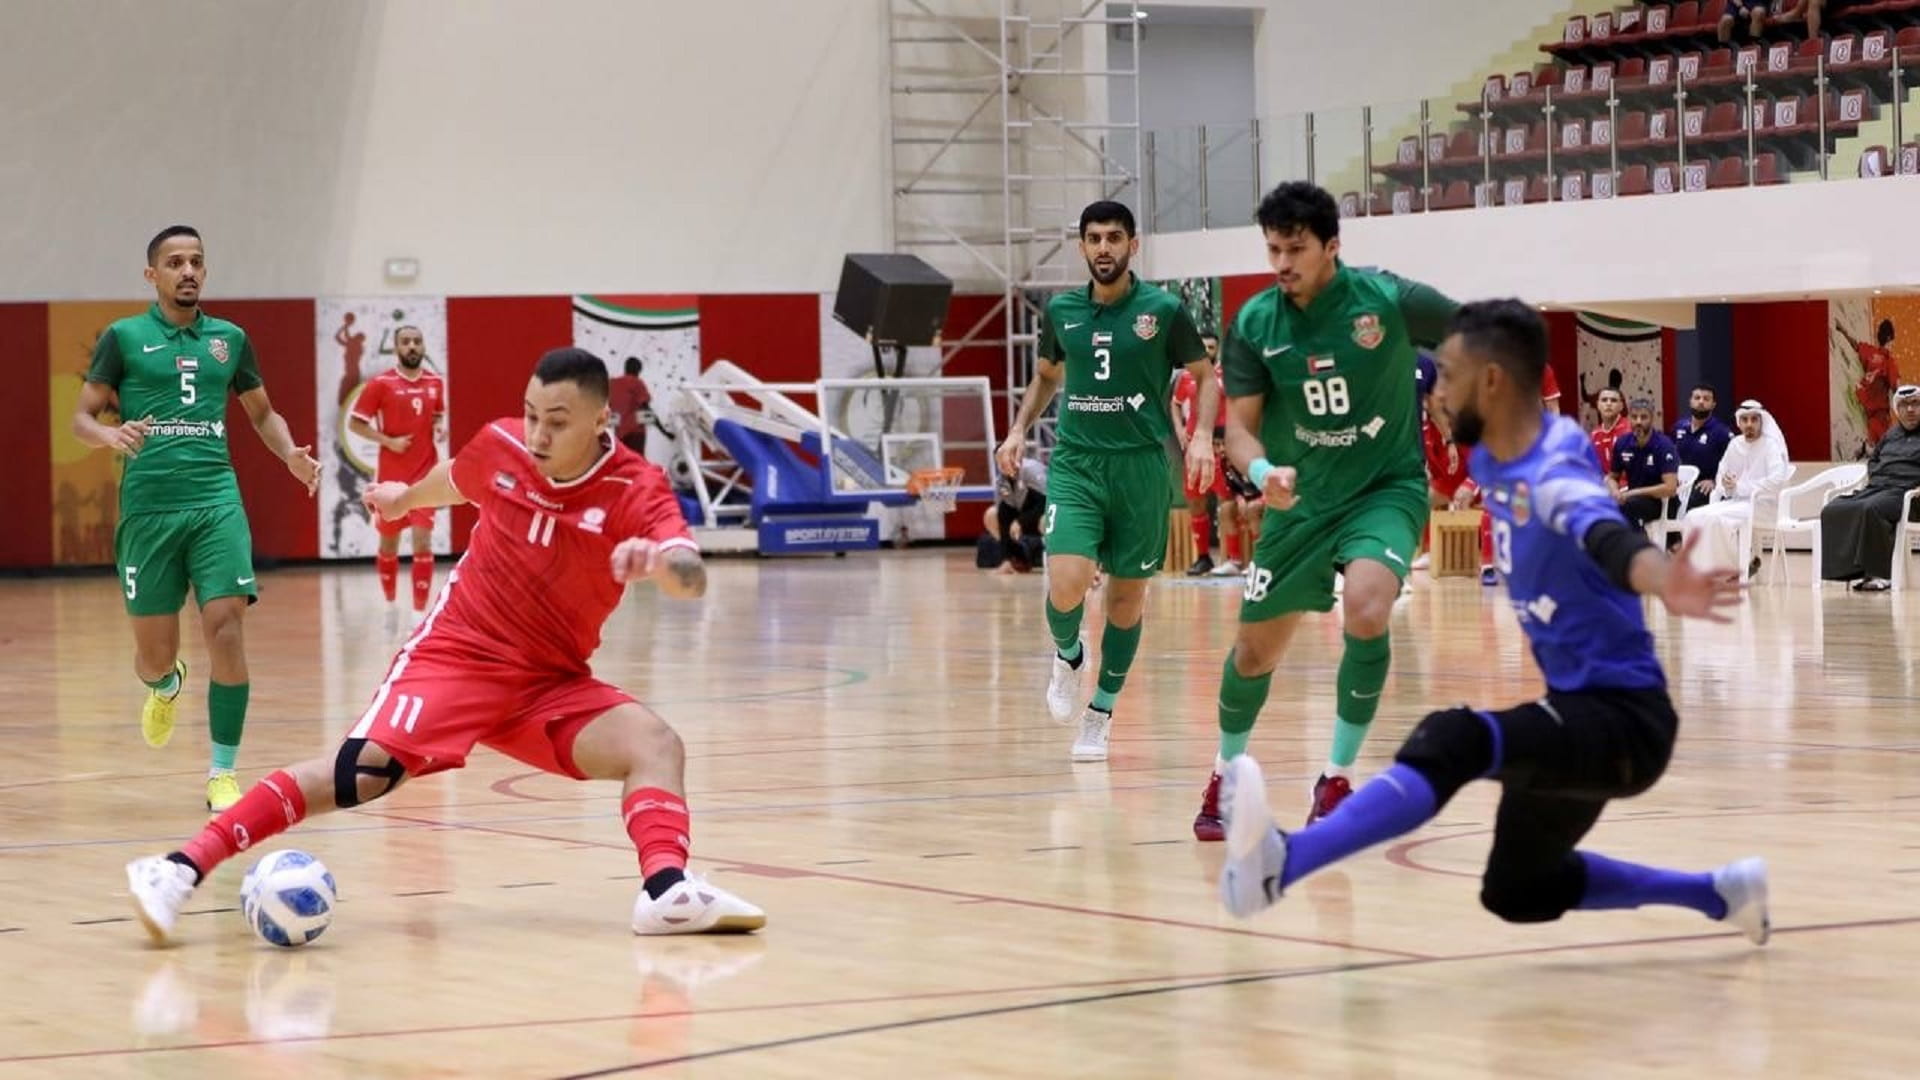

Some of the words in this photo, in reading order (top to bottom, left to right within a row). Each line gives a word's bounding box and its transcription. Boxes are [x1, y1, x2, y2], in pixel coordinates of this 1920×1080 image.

[1094, 348, 1110, 380] 3
[181, 373, 196, 405] 5
[1303, 376, 1350, 415] 88
[412, 398, 422, 415] 9
[1067, 400, 1124, 412] emaratech
[528, 510, 556, 547] 11
[125, 566, 137, 600] 5
[389, 695, 424, 734] 11
